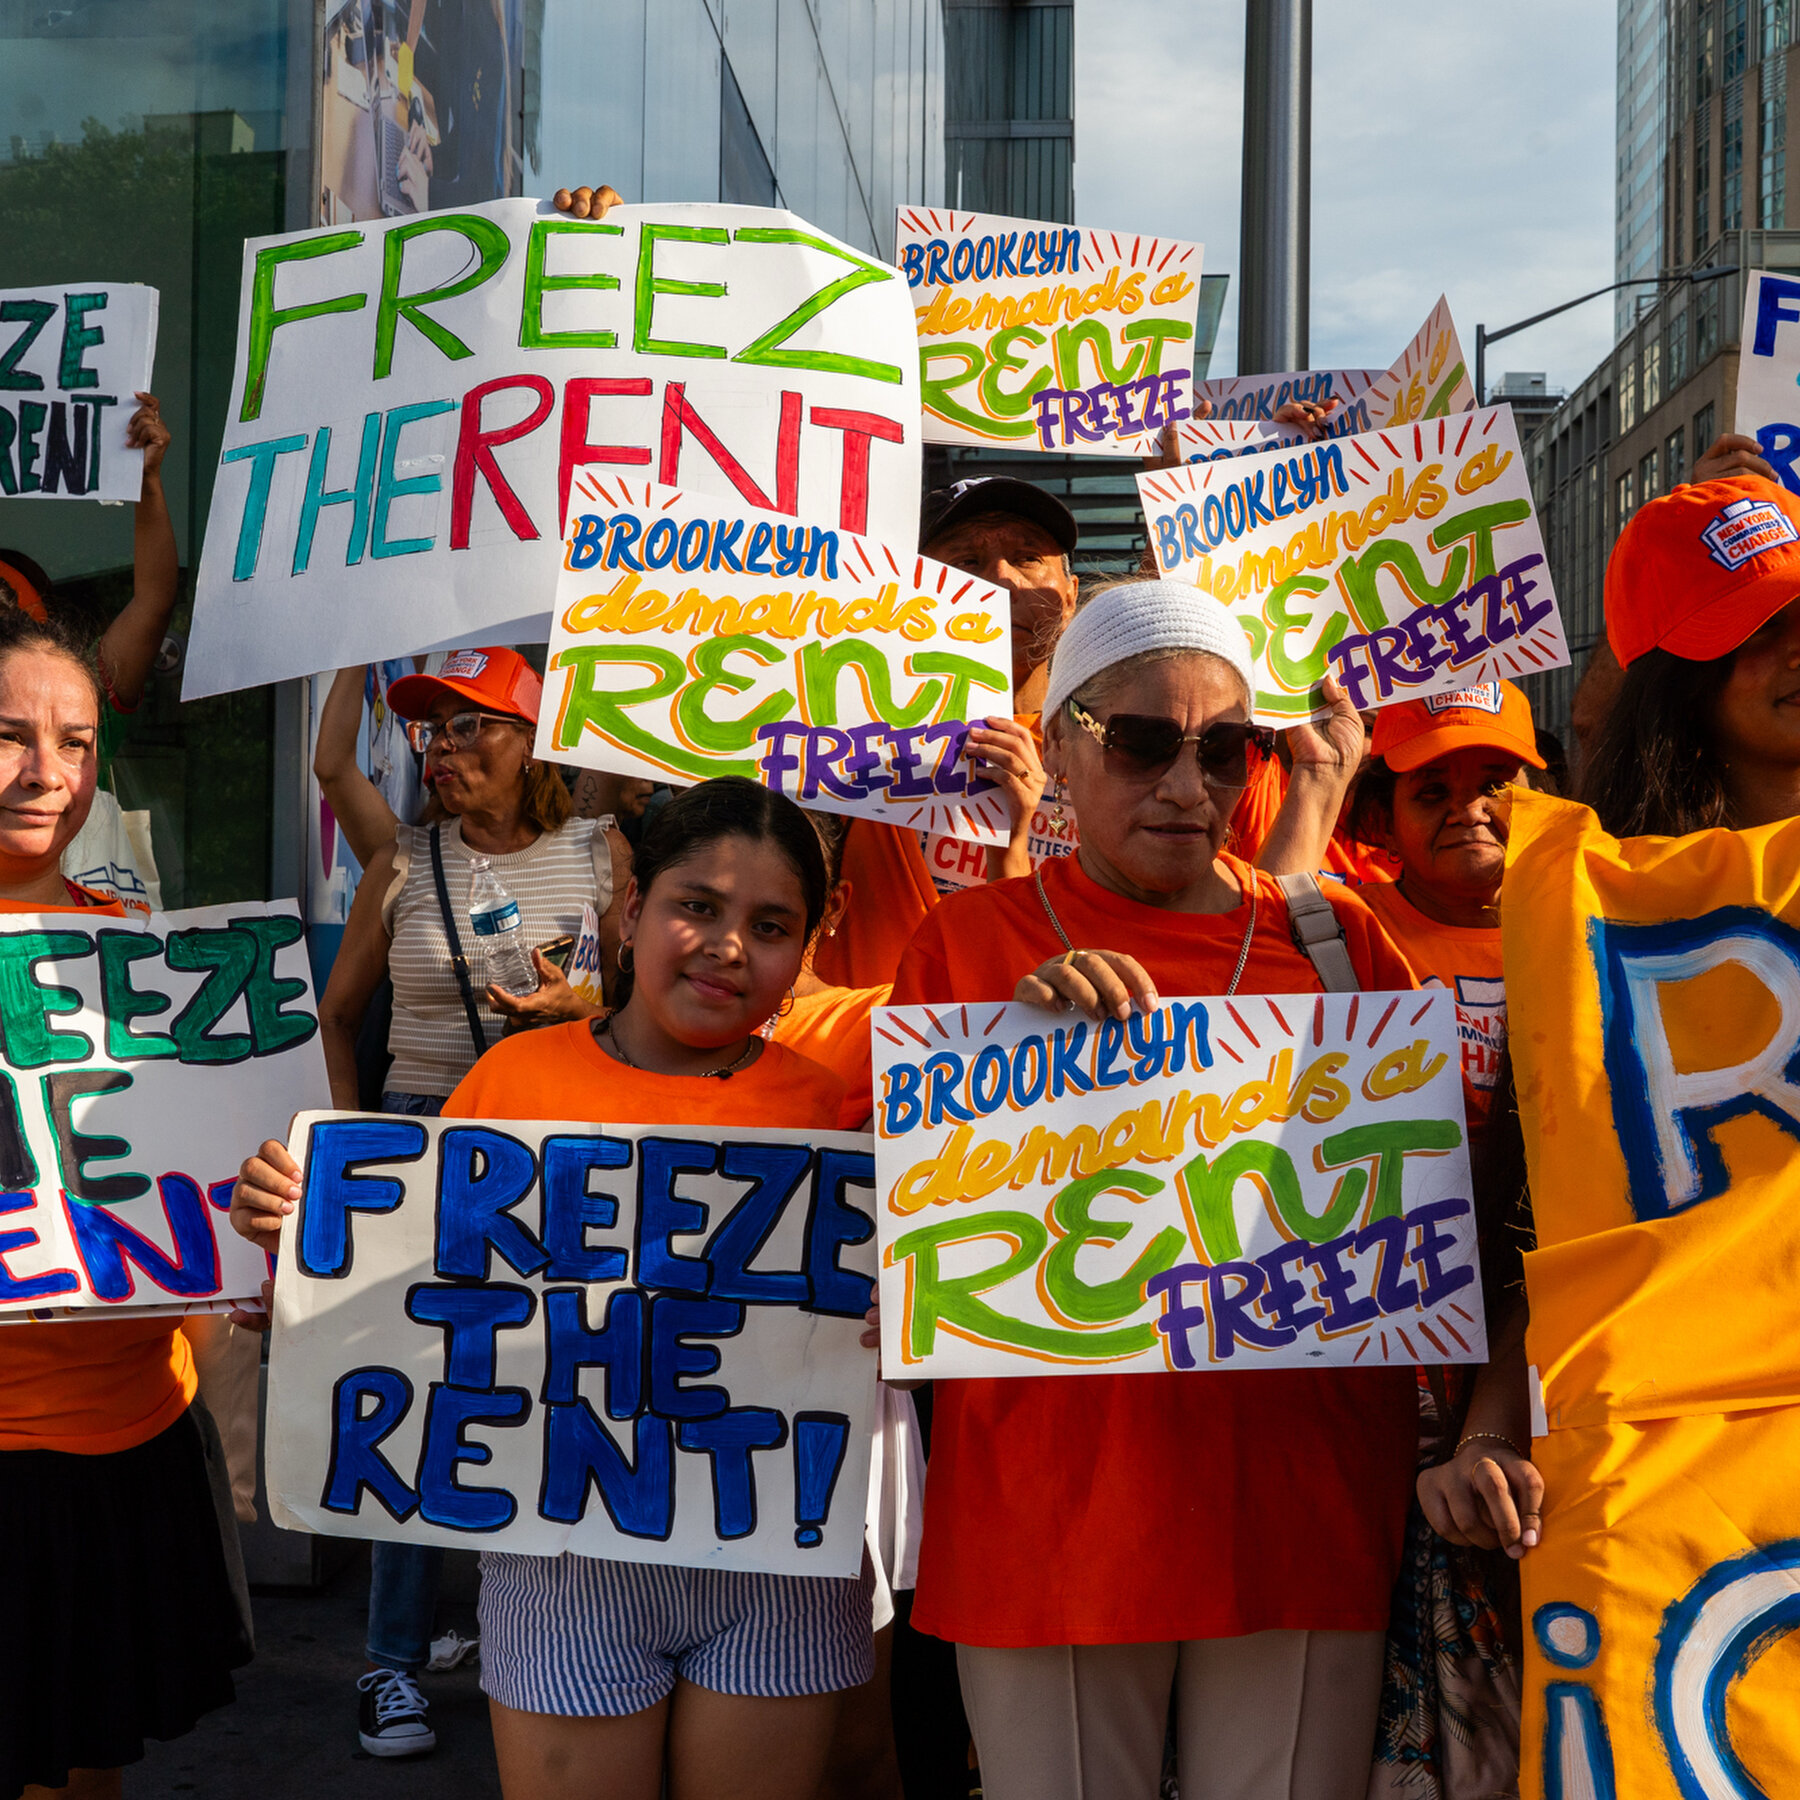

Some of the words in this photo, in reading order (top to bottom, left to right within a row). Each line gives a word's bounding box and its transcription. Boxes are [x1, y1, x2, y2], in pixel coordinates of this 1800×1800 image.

[1150, 271, 1195, 306] a
[1032, 369, 1191, 451] FREEZE
[1454, 443, 1513, 496] a
[1716, 520, 1746, 541] NEW
[1743, 511, 1775, 526] YORK
[1728, 526, 1788, 559] CHANGE
[562, 573, 938, 640] demands
[945, 610, 1003, 643] a
[1325, 553, 1553, 710] FREEZE
[1435, 692, 1491, 706] CHANGE
[888, 1048, 1350, 1215] demands
[1361, 1039, 1448, 1101] a
[298, 1118, 876, 1318] FREEZE
[1140, 1198, 1474, 1371] FREEZE
[405, 1282, 746, 1420] THE
[321, 1366, 850, 1549] RENT!
